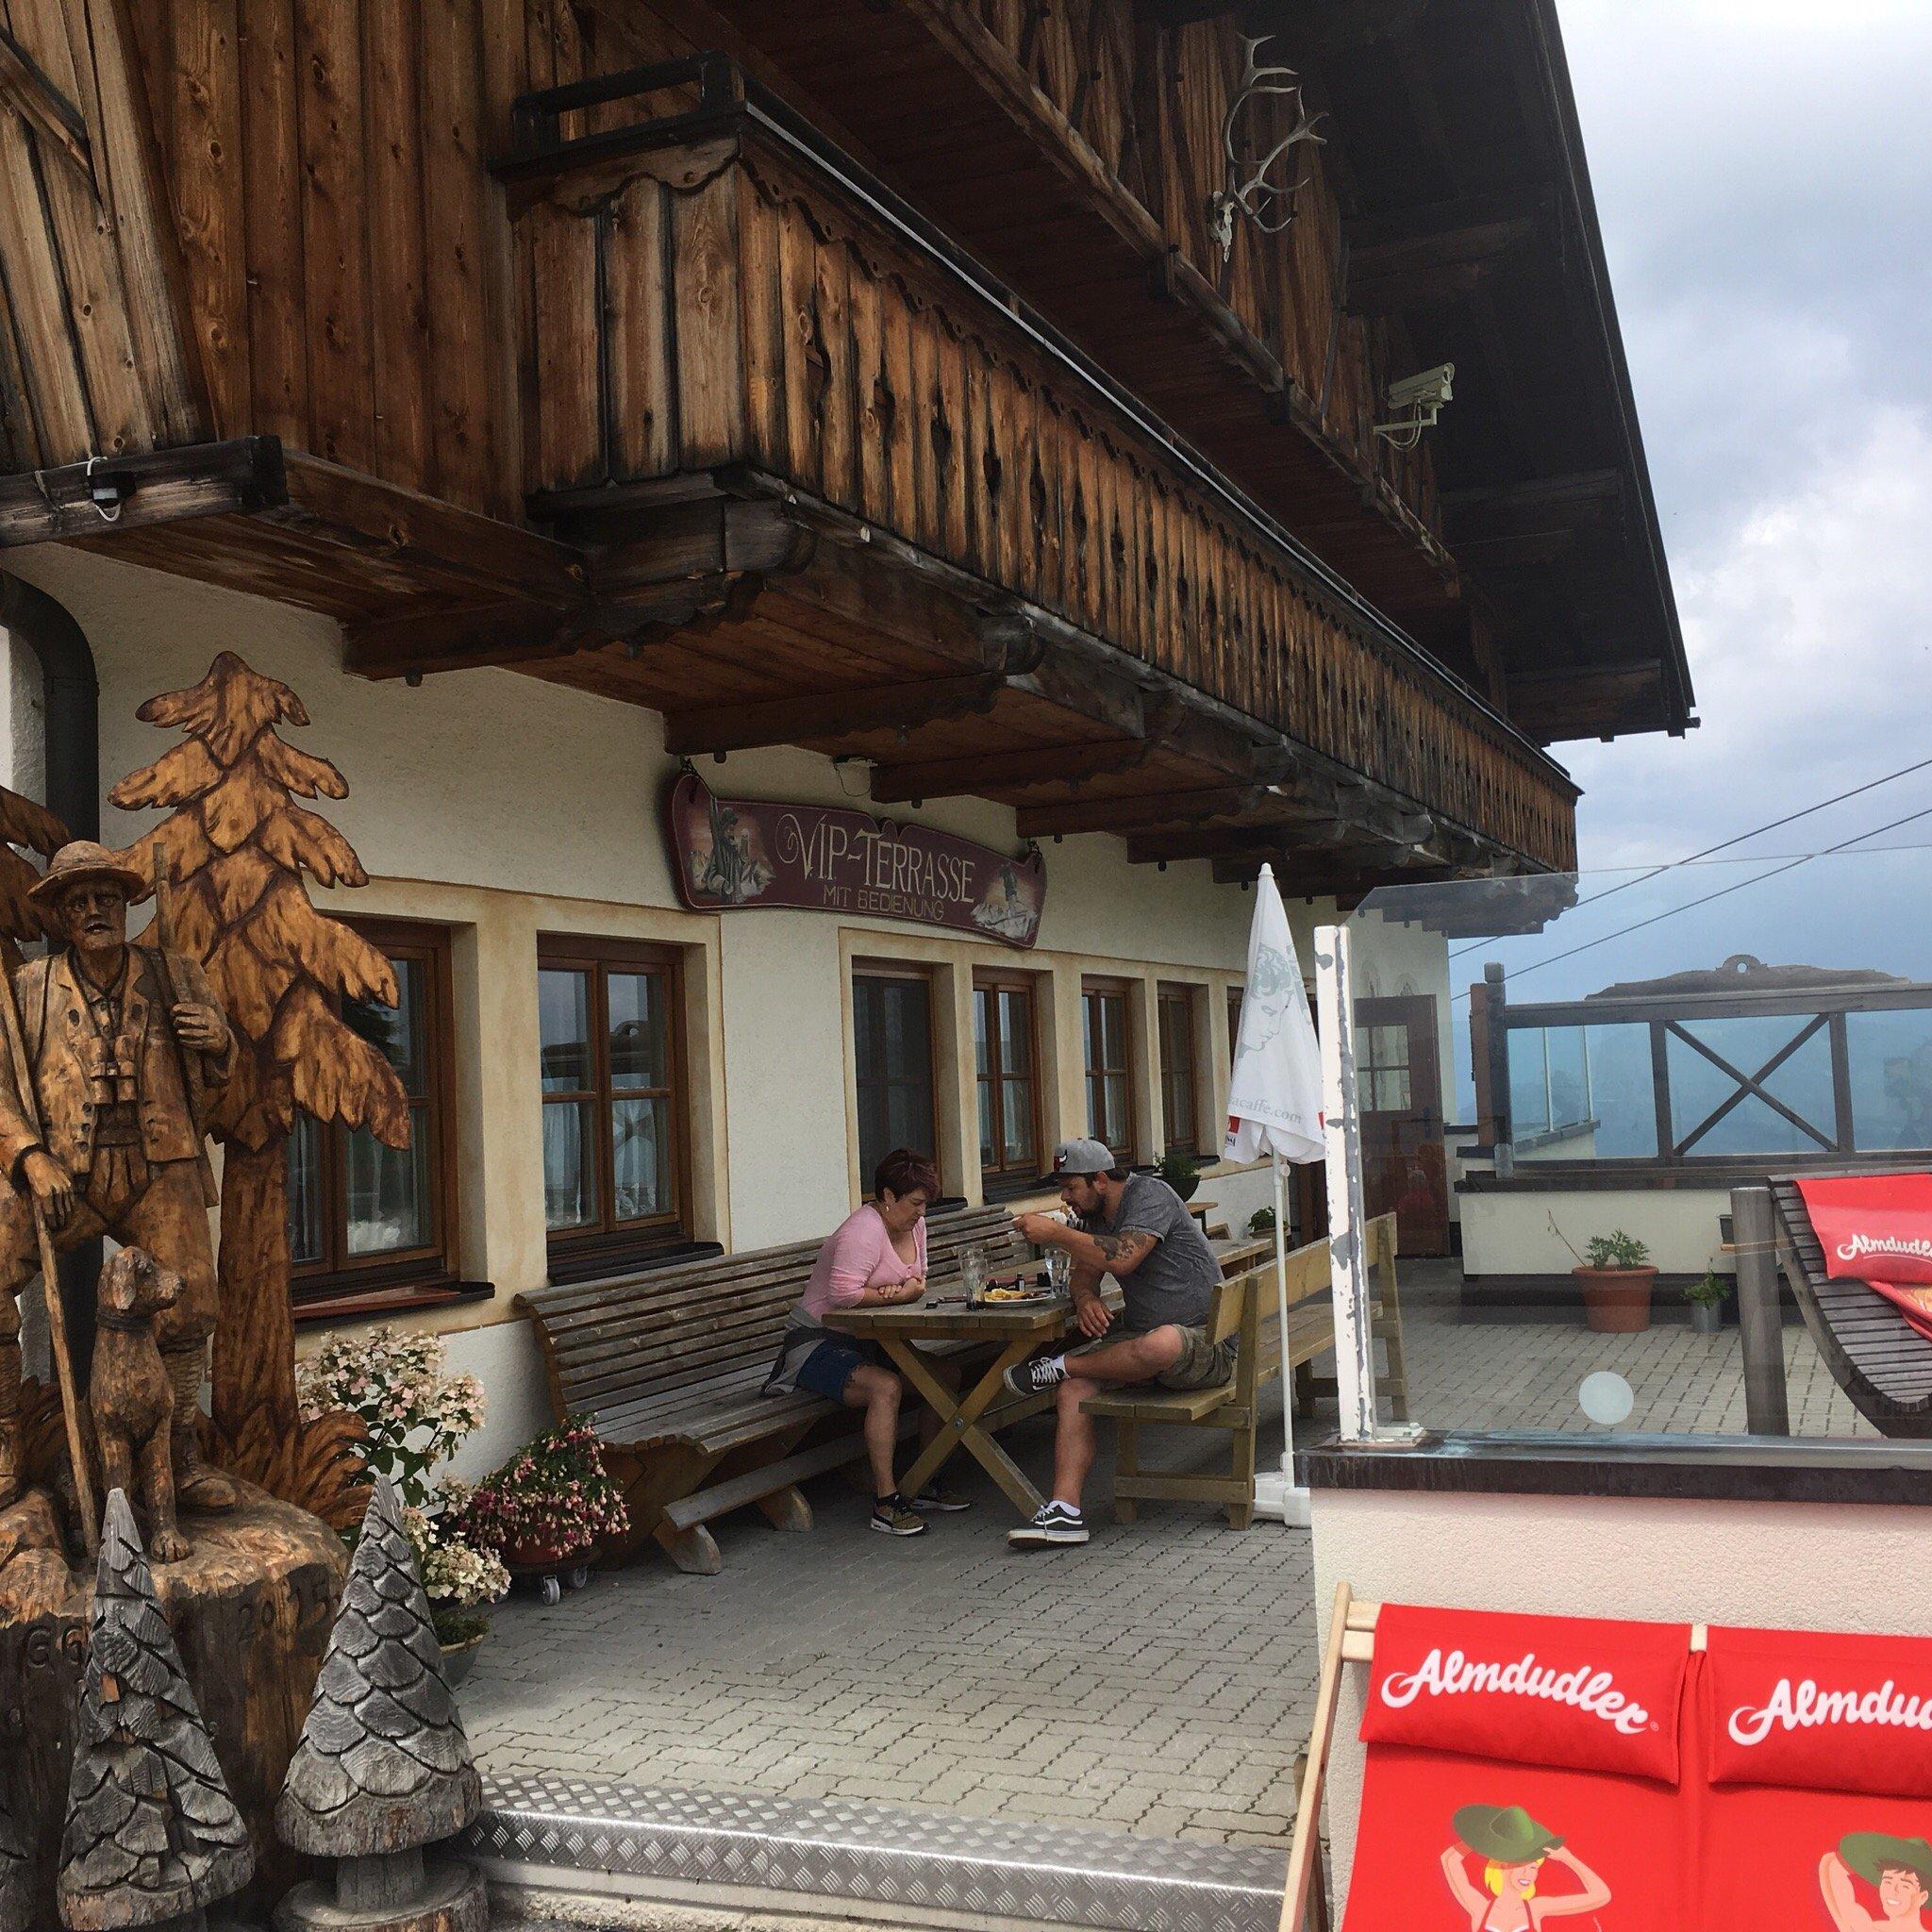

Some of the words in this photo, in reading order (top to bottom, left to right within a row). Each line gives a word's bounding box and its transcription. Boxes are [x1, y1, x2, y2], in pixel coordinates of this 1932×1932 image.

[824, 884, 852, 908] MIT
[858, 889, 944, 921] BEDIENUNG
[1381, 1648, 1649, 1735] Almdudler
